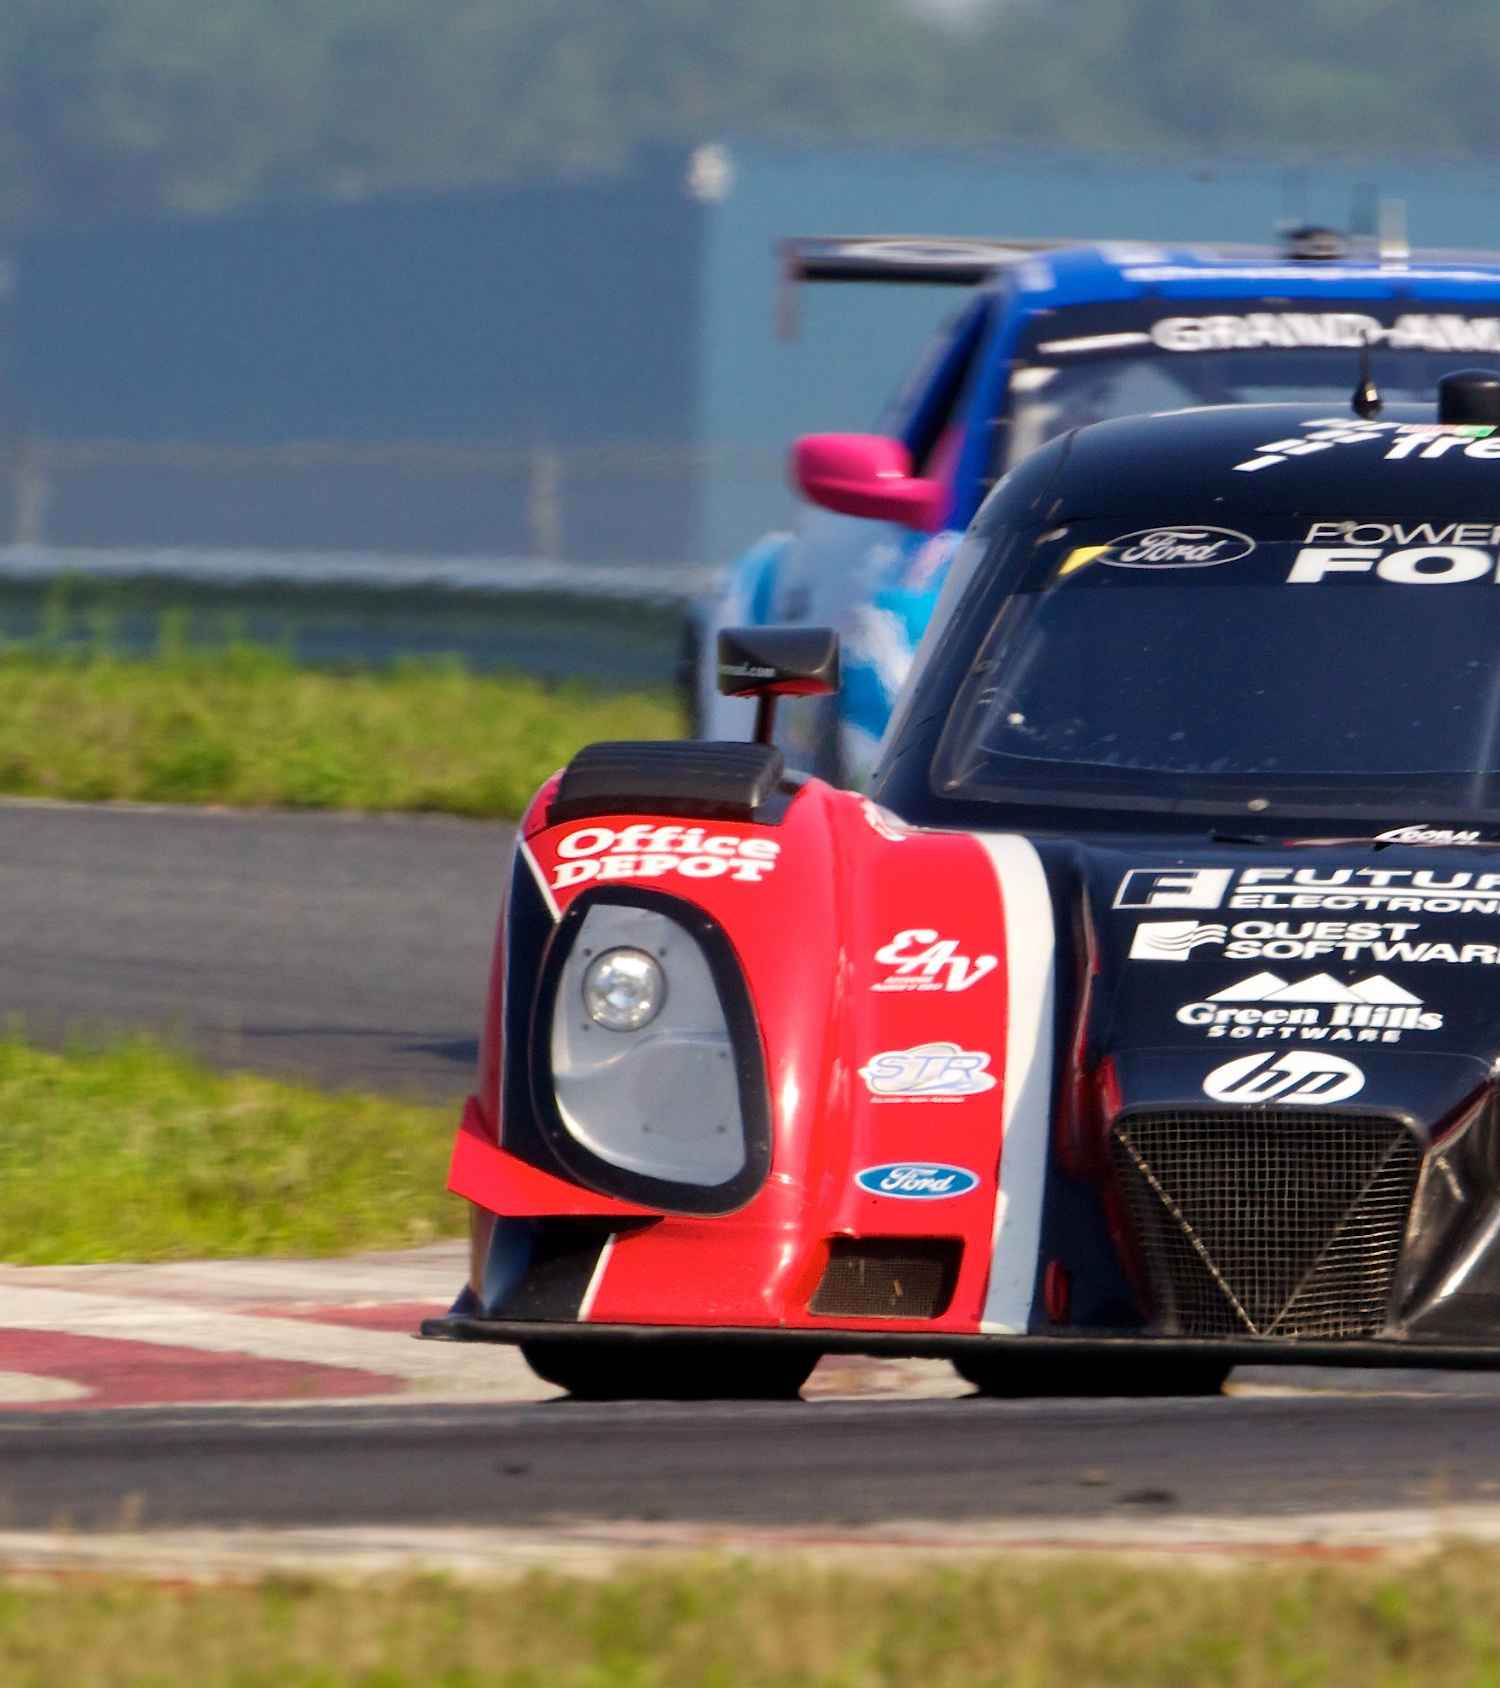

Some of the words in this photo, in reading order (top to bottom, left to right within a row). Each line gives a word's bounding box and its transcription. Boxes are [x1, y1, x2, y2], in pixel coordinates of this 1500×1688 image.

[1120, 531, 1228, 562] Ford
[556, 824, 781, 859] Office
[551, 854, 775, 890] DEPOT
[1231, 920, 1421, 941] QUEST
[1176, 1001, 1320, 1025] Green
[1328, 1001, 1444, 1031] Hills
[1206, 1025, 1403, 1043] SOFTWARE
[1216, 1051, 1353, 1104] hp
[880, 1166, 957, 1192] Ford
